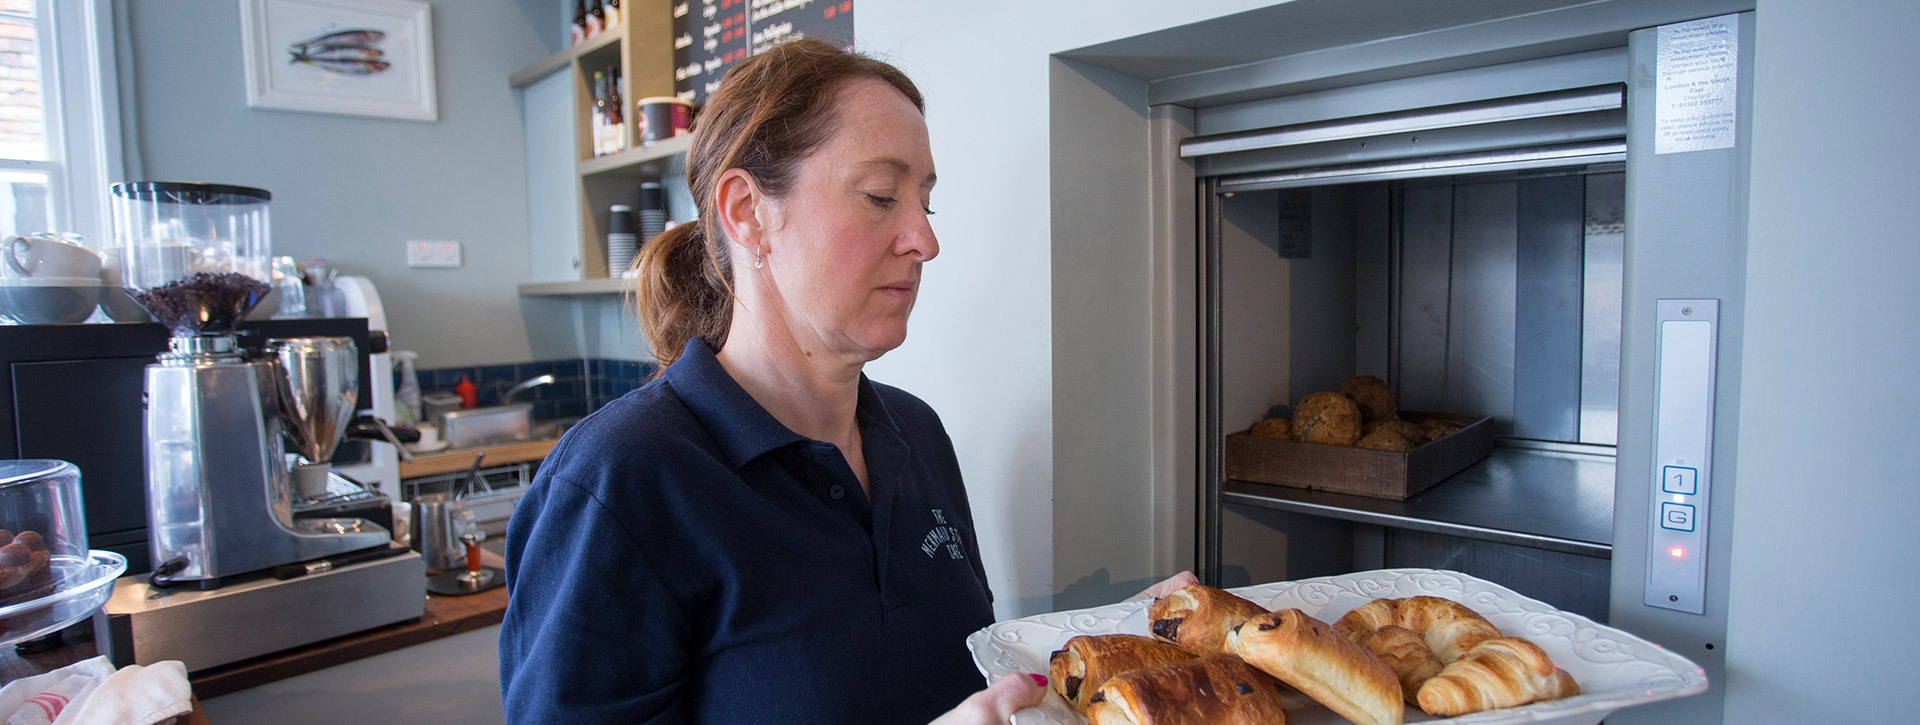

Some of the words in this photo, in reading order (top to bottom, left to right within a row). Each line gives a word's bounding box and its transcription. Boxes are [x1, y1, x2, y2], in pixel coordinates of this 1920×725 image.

[1665, 82, 1690, 90] London
[1673, 473, 1682, 487] 1
[931, 509, 947, 524] THE
[1668, 510, 1687, 524] G
[920, 526, 950, 559] MERMAID
